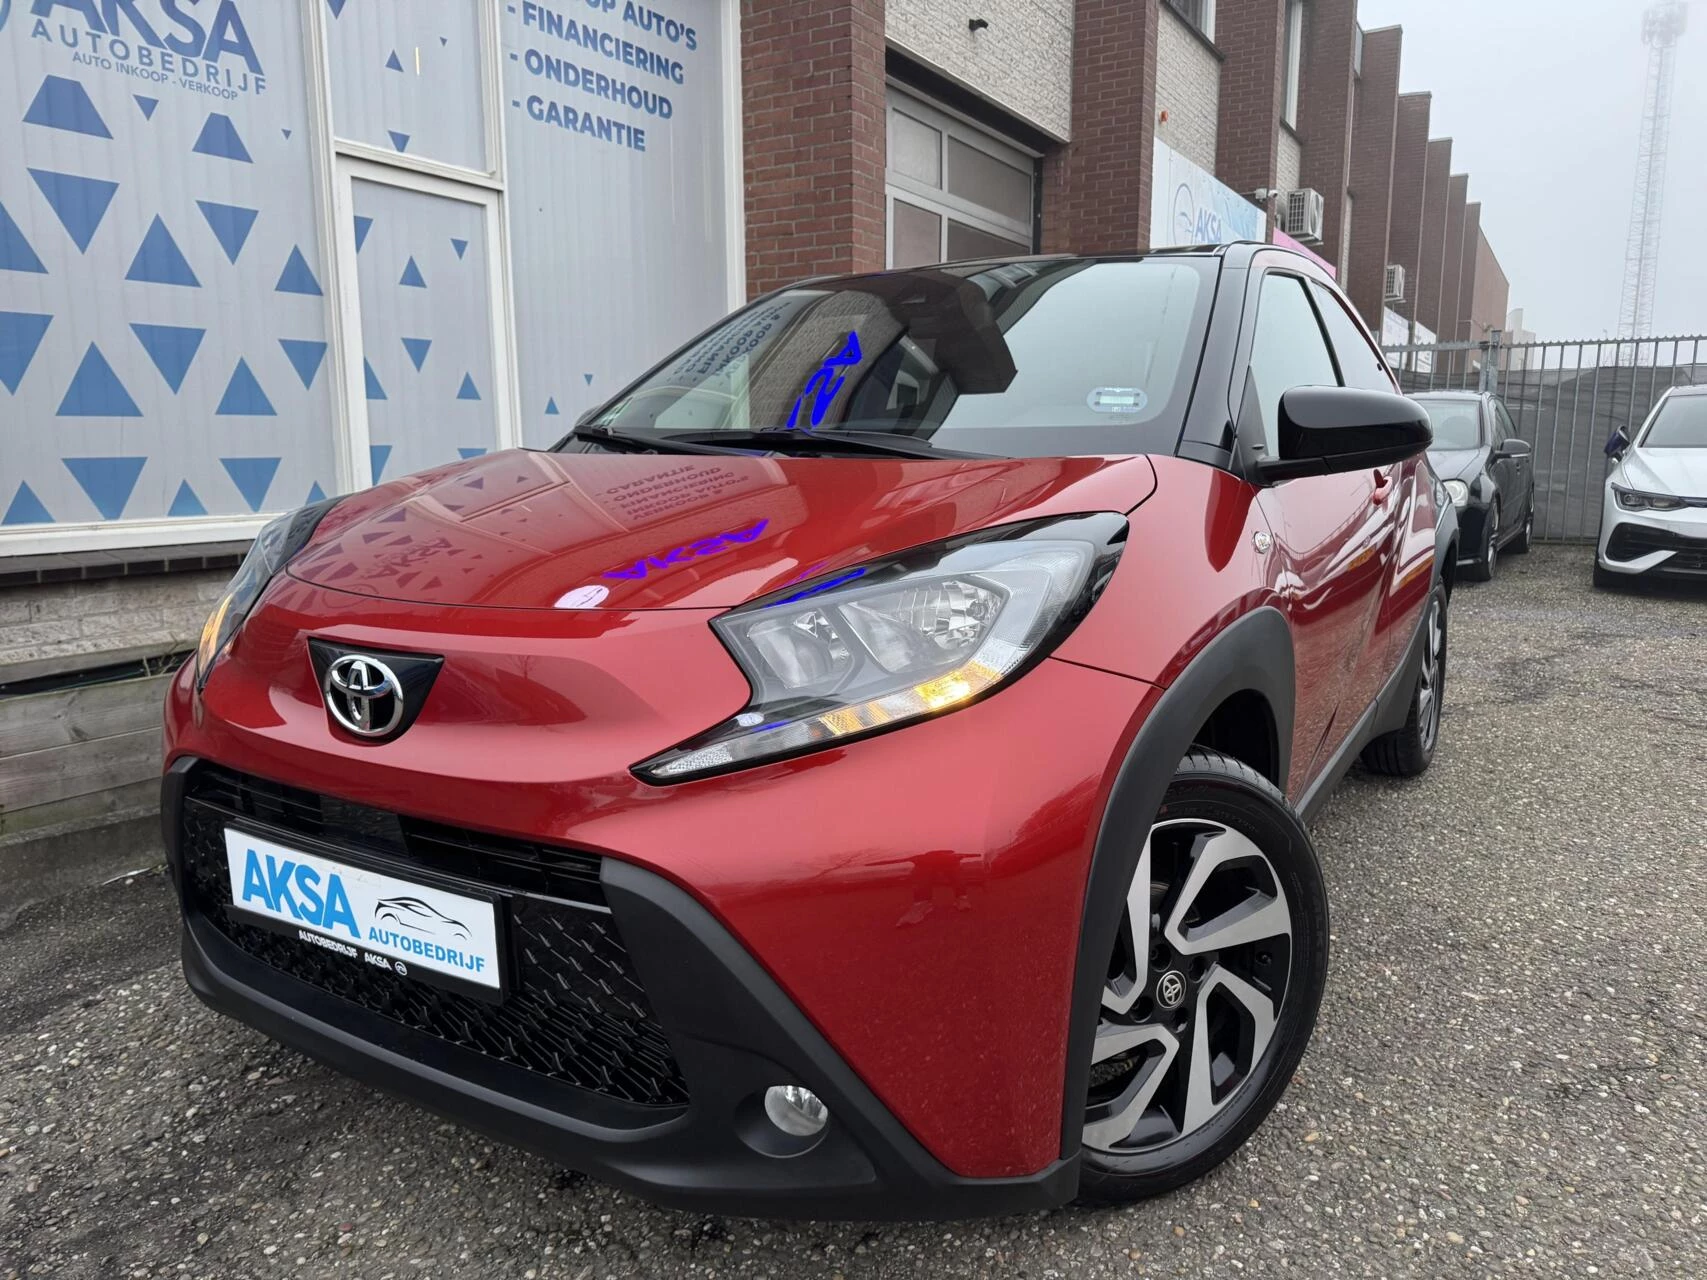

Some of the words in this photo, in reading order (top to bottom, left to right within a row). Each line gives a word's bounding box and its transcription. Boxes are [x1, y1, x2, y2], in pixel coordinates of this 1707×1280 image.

[522, 0, 684, 85] FINANCIERING
[622, 0, 697, 51] AUTO'S
[31, 18, 267, 95] AUTOBEDRIJF
[72, 51, 112, 70] AUTO
[115, 61, 168, 85] INKOOP
[179, 78, 238, 100] VERKOOP
[524, 48, 673, 120] ONDERHOUD
[526, 95, 646, 152] GARANTIE
[1194, 206, 1222, 244] AKSA
[242, 848, 361, 939] AKSA
[298, 929, 358, 959] AUTOBEDRIJF
[364, 952, 392, 972] AKSA
[368, 926, 485, 973] AUTOBEDRIJF
